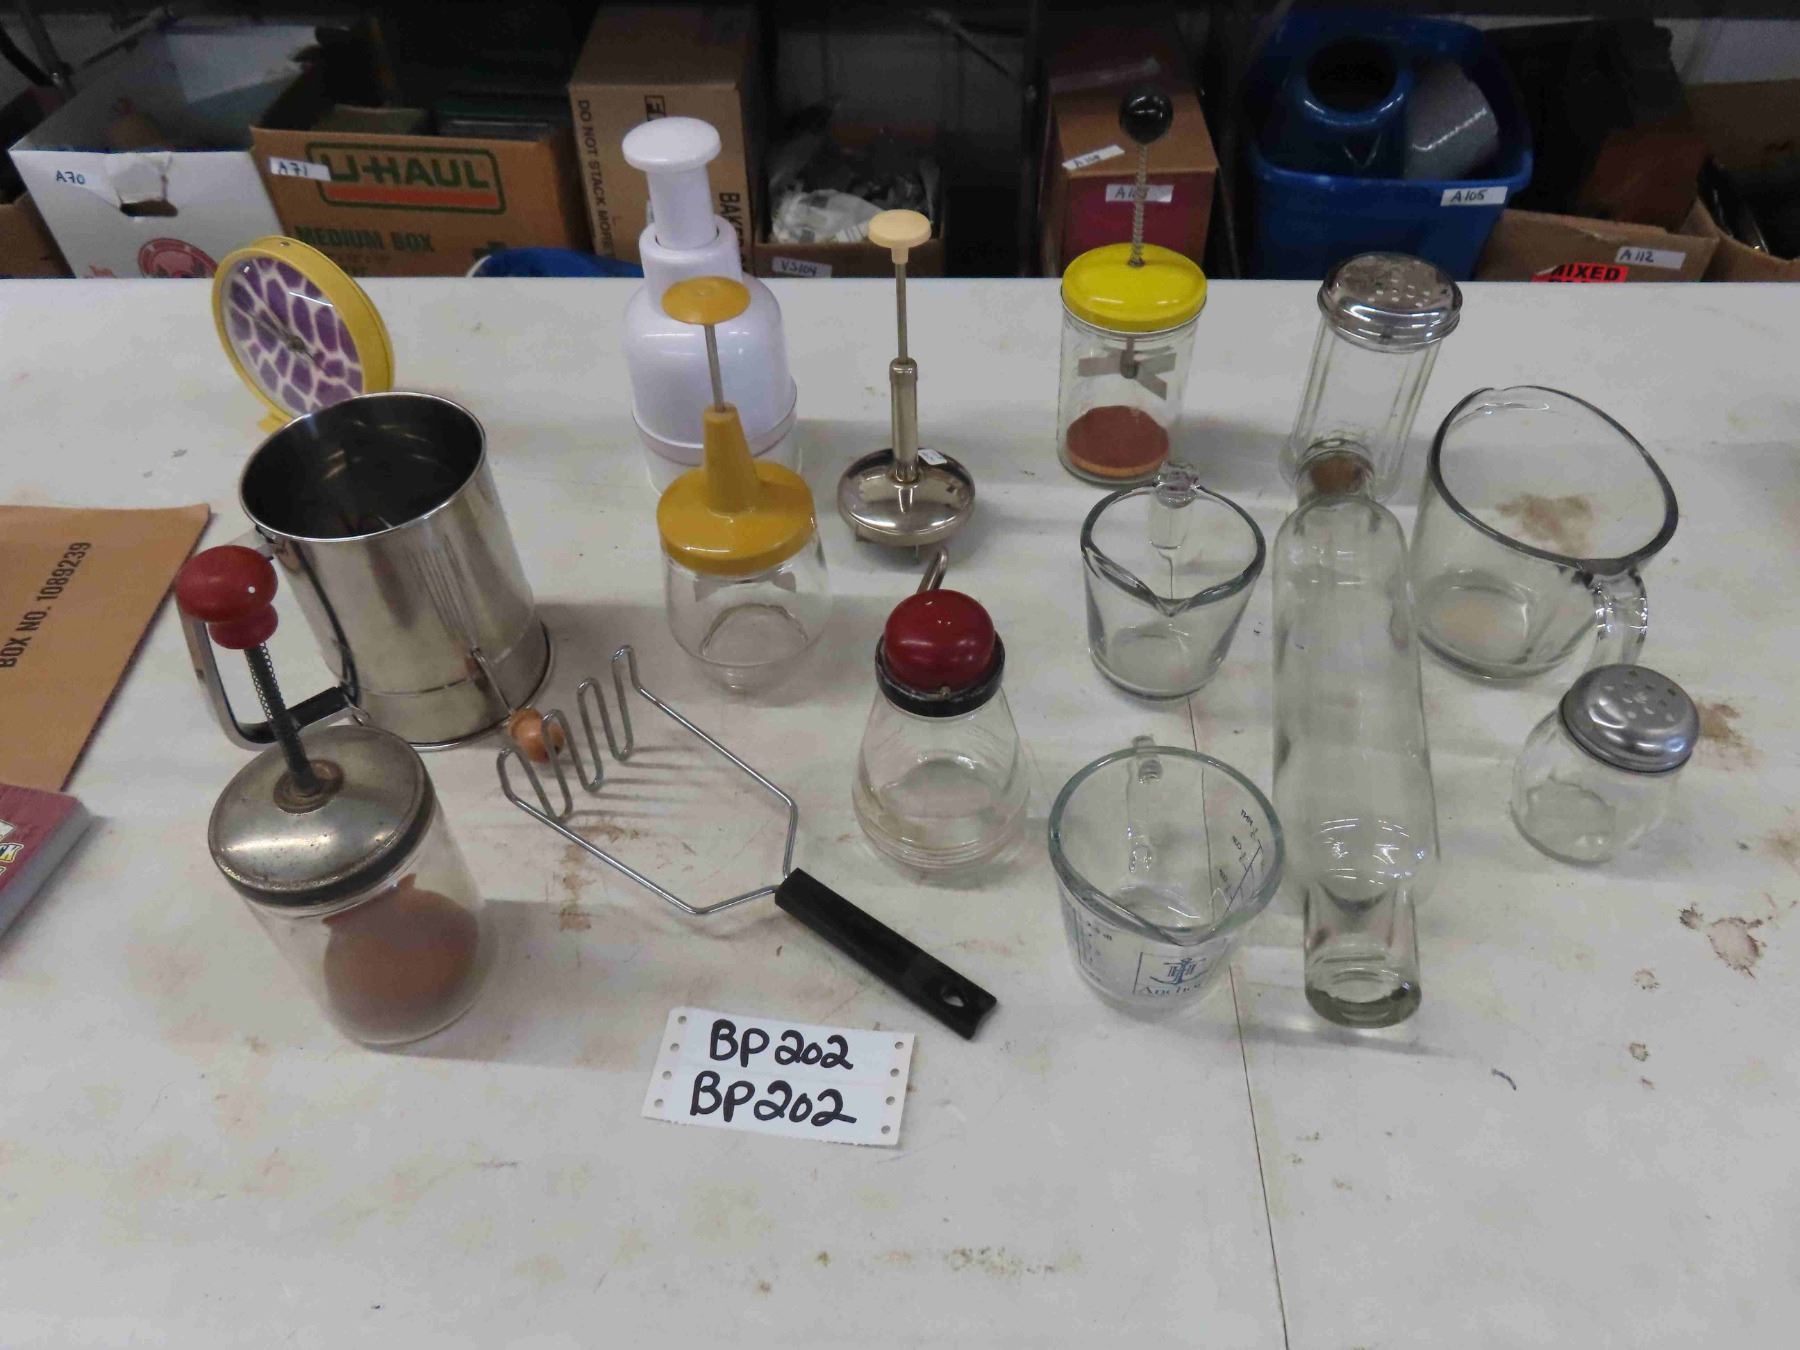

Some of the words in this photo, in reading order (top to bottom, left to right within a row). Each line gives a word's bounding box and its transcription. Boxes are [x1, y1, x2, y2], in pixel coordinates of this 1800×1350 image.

[577, 100, 592, 122] DO
[583, 127, 599, 156] NOT
[55, 169, 86, 185] A70
[320, 153, 490, 190] U-HAUL
[588, 161, 606, 206] STACK
[1450, 189, 1489, 202] A105
[295, 226, 385, 250] MEDIUM
[390, 231, 436, 252] BOX
[1619, 249, 1655, 263] A112
[36, 541, 92, 602] 1089239
[15, 605, 53, 632] NO.
[0, 636, 32, 669] BOX
[709, 1018, 855, 1070] BP202
[689, 1070, 858, 1127] BP202
